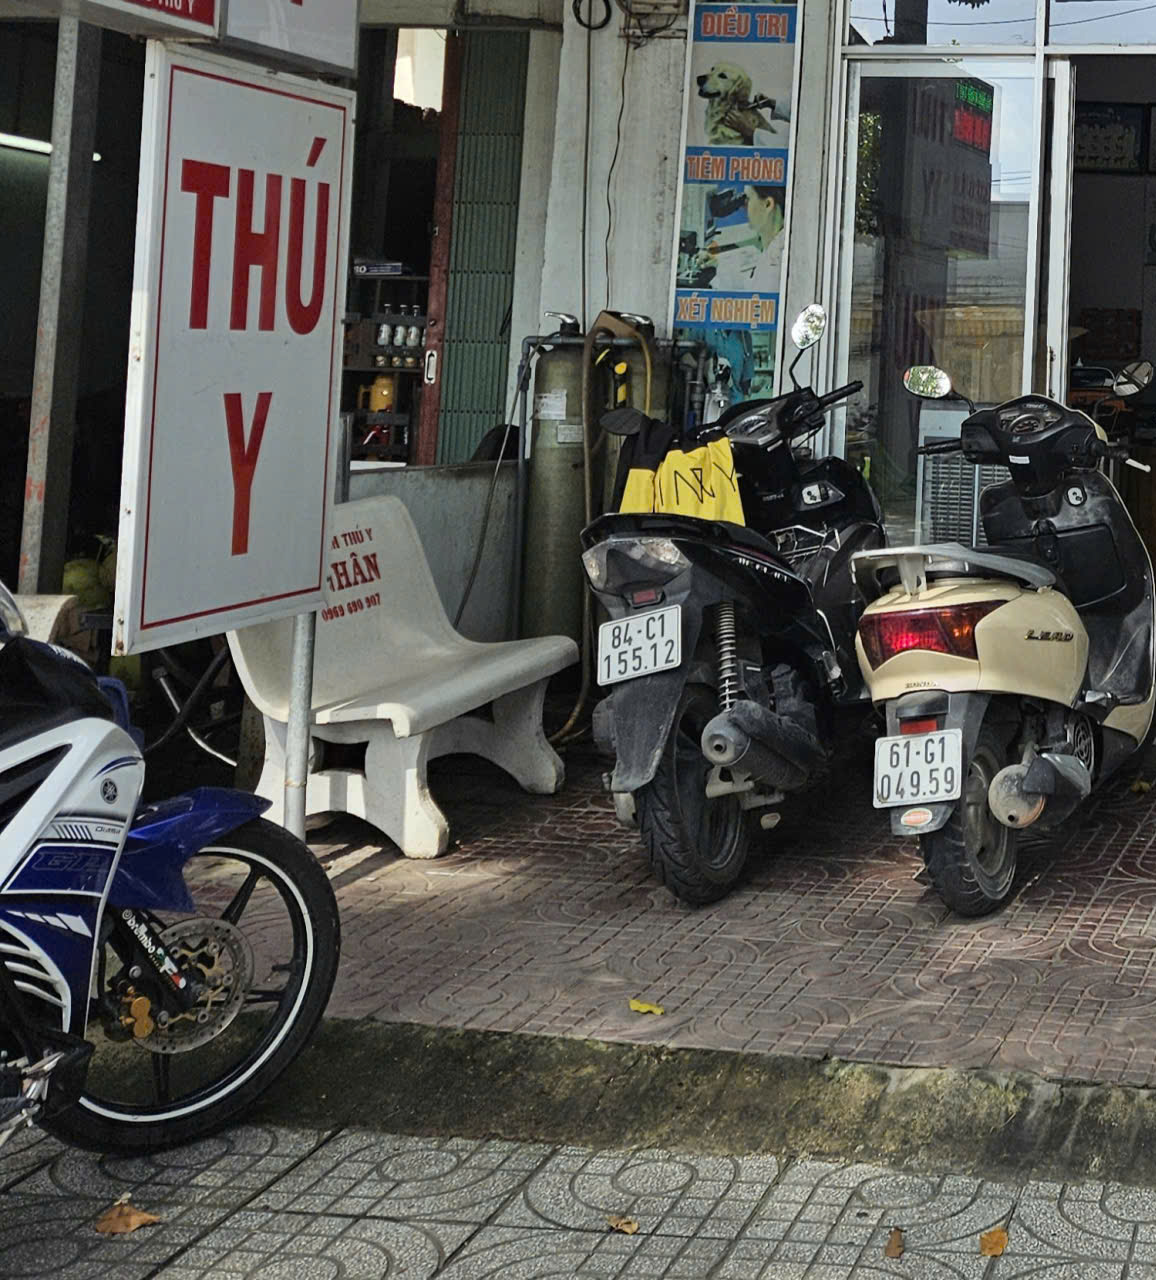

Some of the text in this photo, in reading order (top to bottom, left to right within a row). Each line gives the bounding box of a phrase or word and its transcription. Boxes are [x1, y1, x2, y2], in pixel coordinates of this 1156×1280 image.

[181, 136, 331, 336] THÚ
[223, 392, 273, 557] Y
[611, 613, 666, 649] 84-C1
[603, 639, 676, 680] 155.12
[889, 736, 946, 769] 61-G1
[880, 765, 955, 801] 049.59
